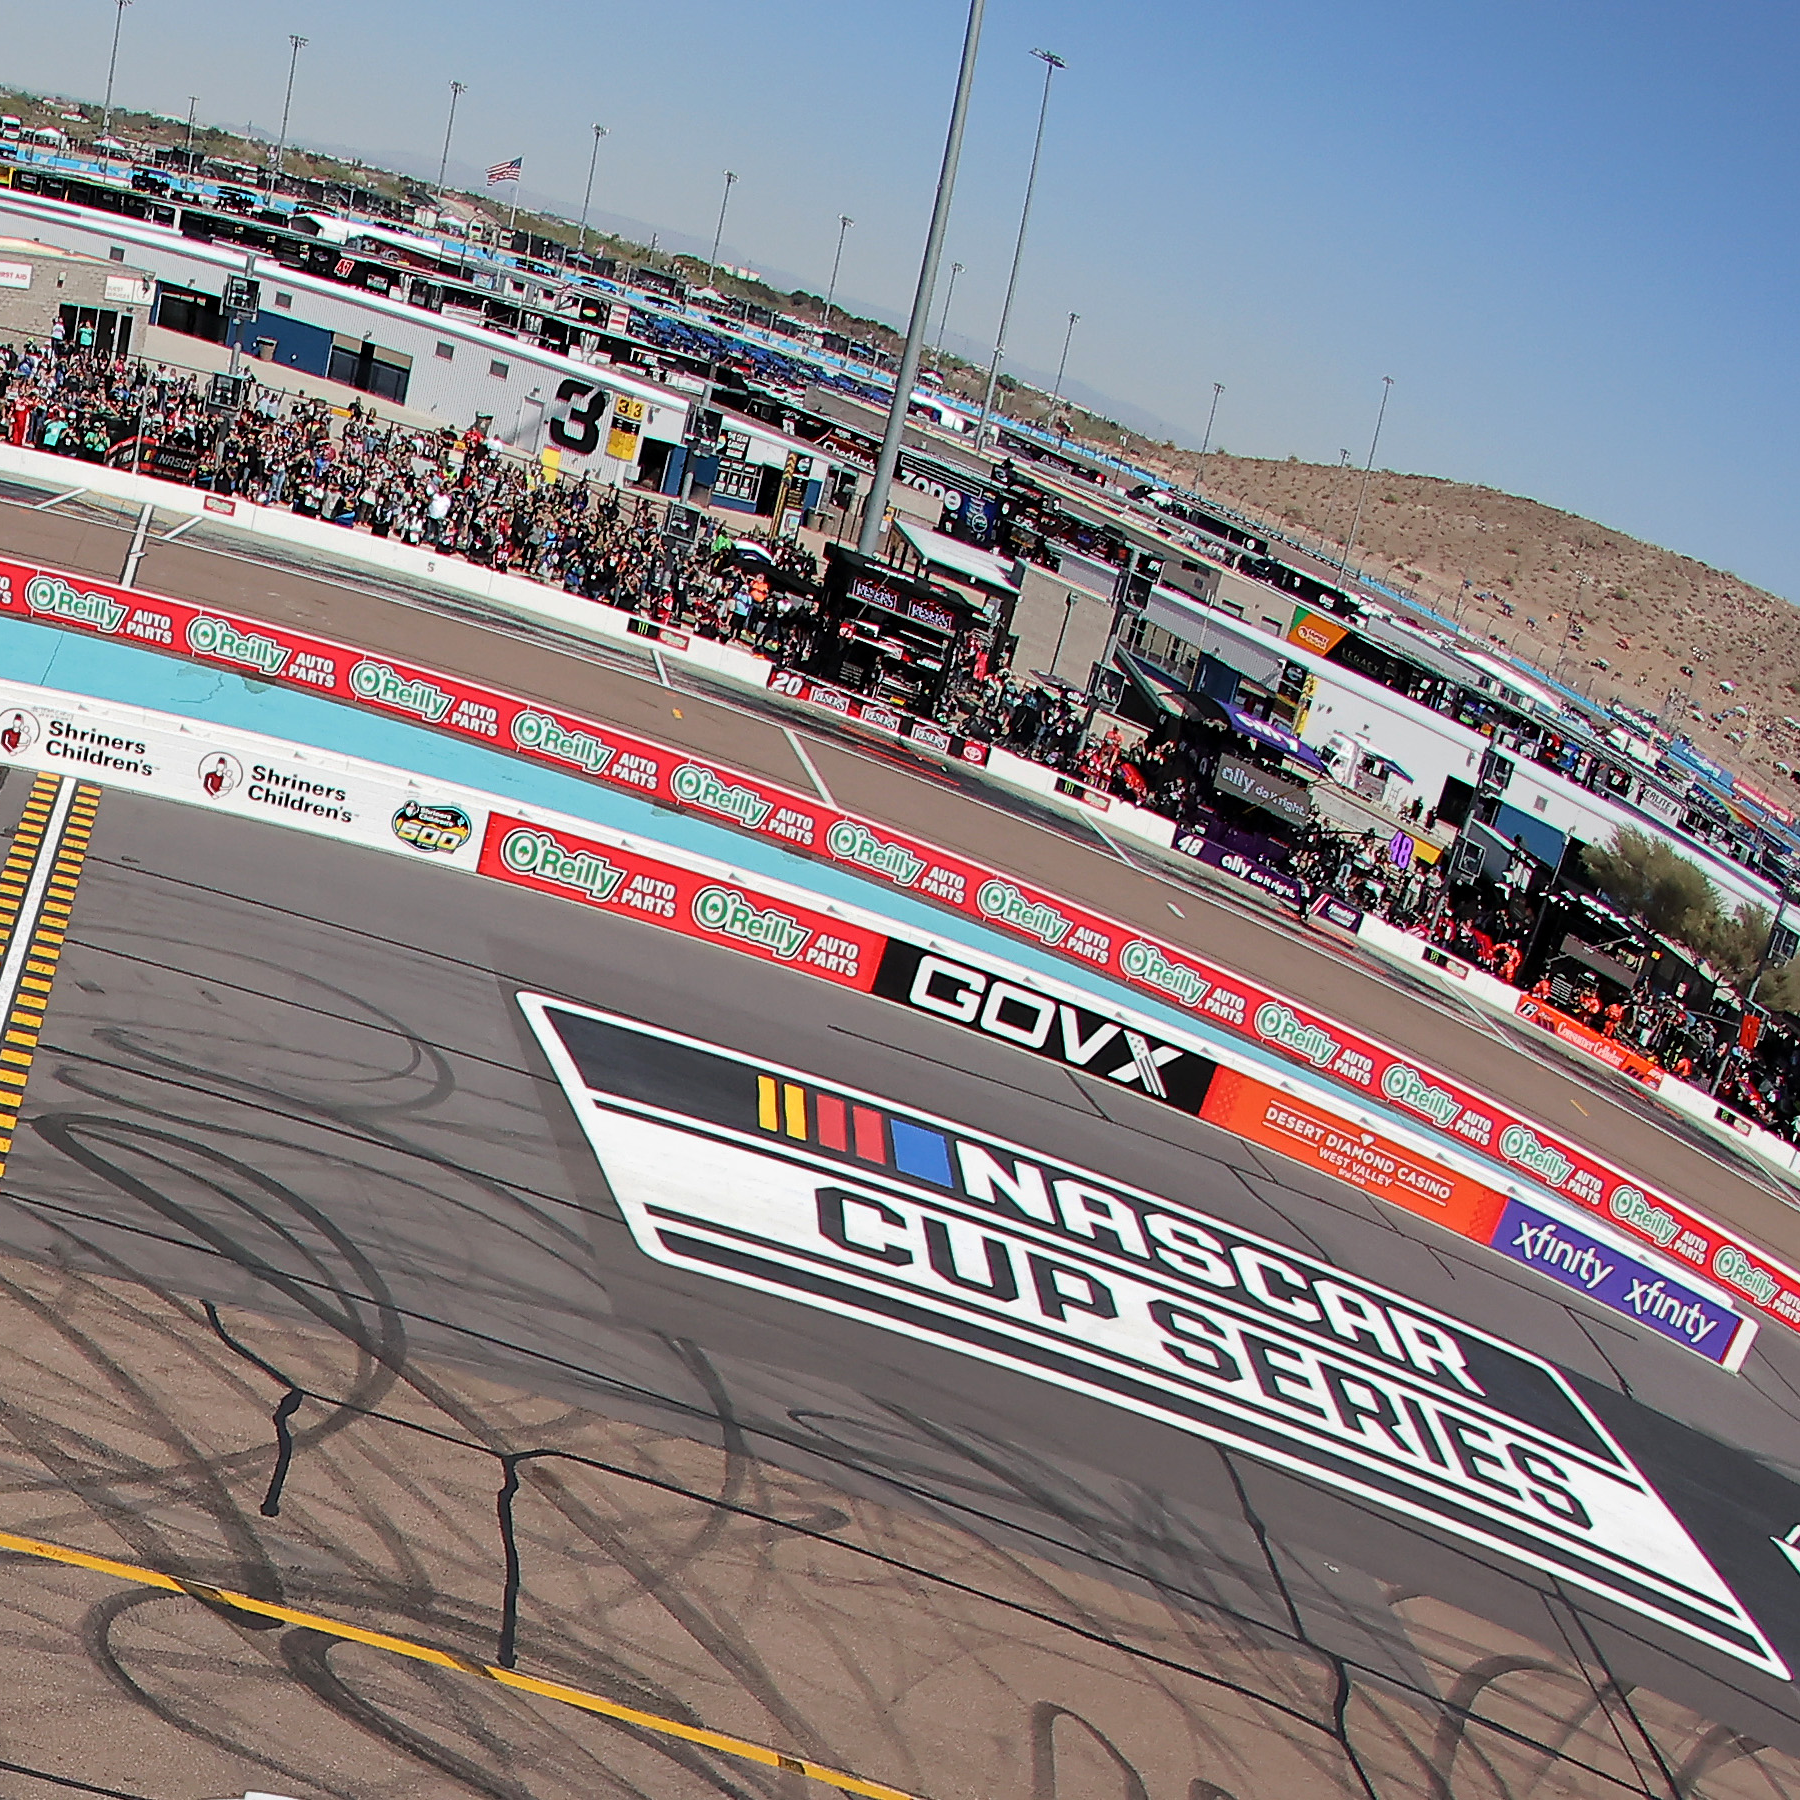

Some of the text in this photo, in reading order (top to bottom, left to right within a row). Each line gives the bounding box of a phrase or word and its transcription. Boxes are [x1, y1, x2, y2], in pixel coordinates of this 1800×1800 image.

[14, 272, 28, 282] AID
[336, 258, 355, 278] 47
[549, 379, 607, 455] 3
[901, 468, 963, 511] zone
[30, 580, 123, 629] O'Reilly
[134, 609, 171, 629] AUTO
[127, 620, 172, 644] PARTS
[771, 671, 804, 696] 20
[49, 719, 147, 756] Shriners
[515, 711, 610, 771] O'Reilly
[46, 741, 153, 778] Children's
[612, 764, 659, 789] PARTS
[620, 752, 657, 775] AUTO
[250, 762, 346, 802] Shriners
[1221, 764, 1256, 794] ally
[248, 784, 354, 824] Children's
[398, 820, 460, 850] 500
[1176, 834, 1205, 856] 48
[505, 830, 621, 900] O'Reilly
[1221, 854, 1252, 879] ally
[623, 887, 676, 918] PARTS
[630, 873, 676, 900] AUTO
[696, 886, 809, 958] O'Reilly
[807, 945, 859, 978] PARTS
[816, 934, 859, 959] AUTO
[1124, 942, 1208, 1007] O'Reilly
[1207, 998, 1244, 1024] PARTS
[1213, 988, 1245, 1009] AUTO
[911, 955, 1190, 1098] GOVX
[1557, 1021, 1625, 1068] Consumer Cellular
[1386, 1065, 1459, 1123] O'Reilly
[1454, 1120, 1489, 1147] PARTS
[1463, 1109, 1492, 1130] AUTO
[1265, 1106, 1452, 1200] DESERT DIAMOND CASINO
[1318, 1146, 1394, 1187] WEST VALLEY
[957, 1140, 1486, 1396] NASCAR
[1511, 1218, 1718, 1344] xfinity xfinity
[815, 1184, 1595, 1531] CUP SERIES
